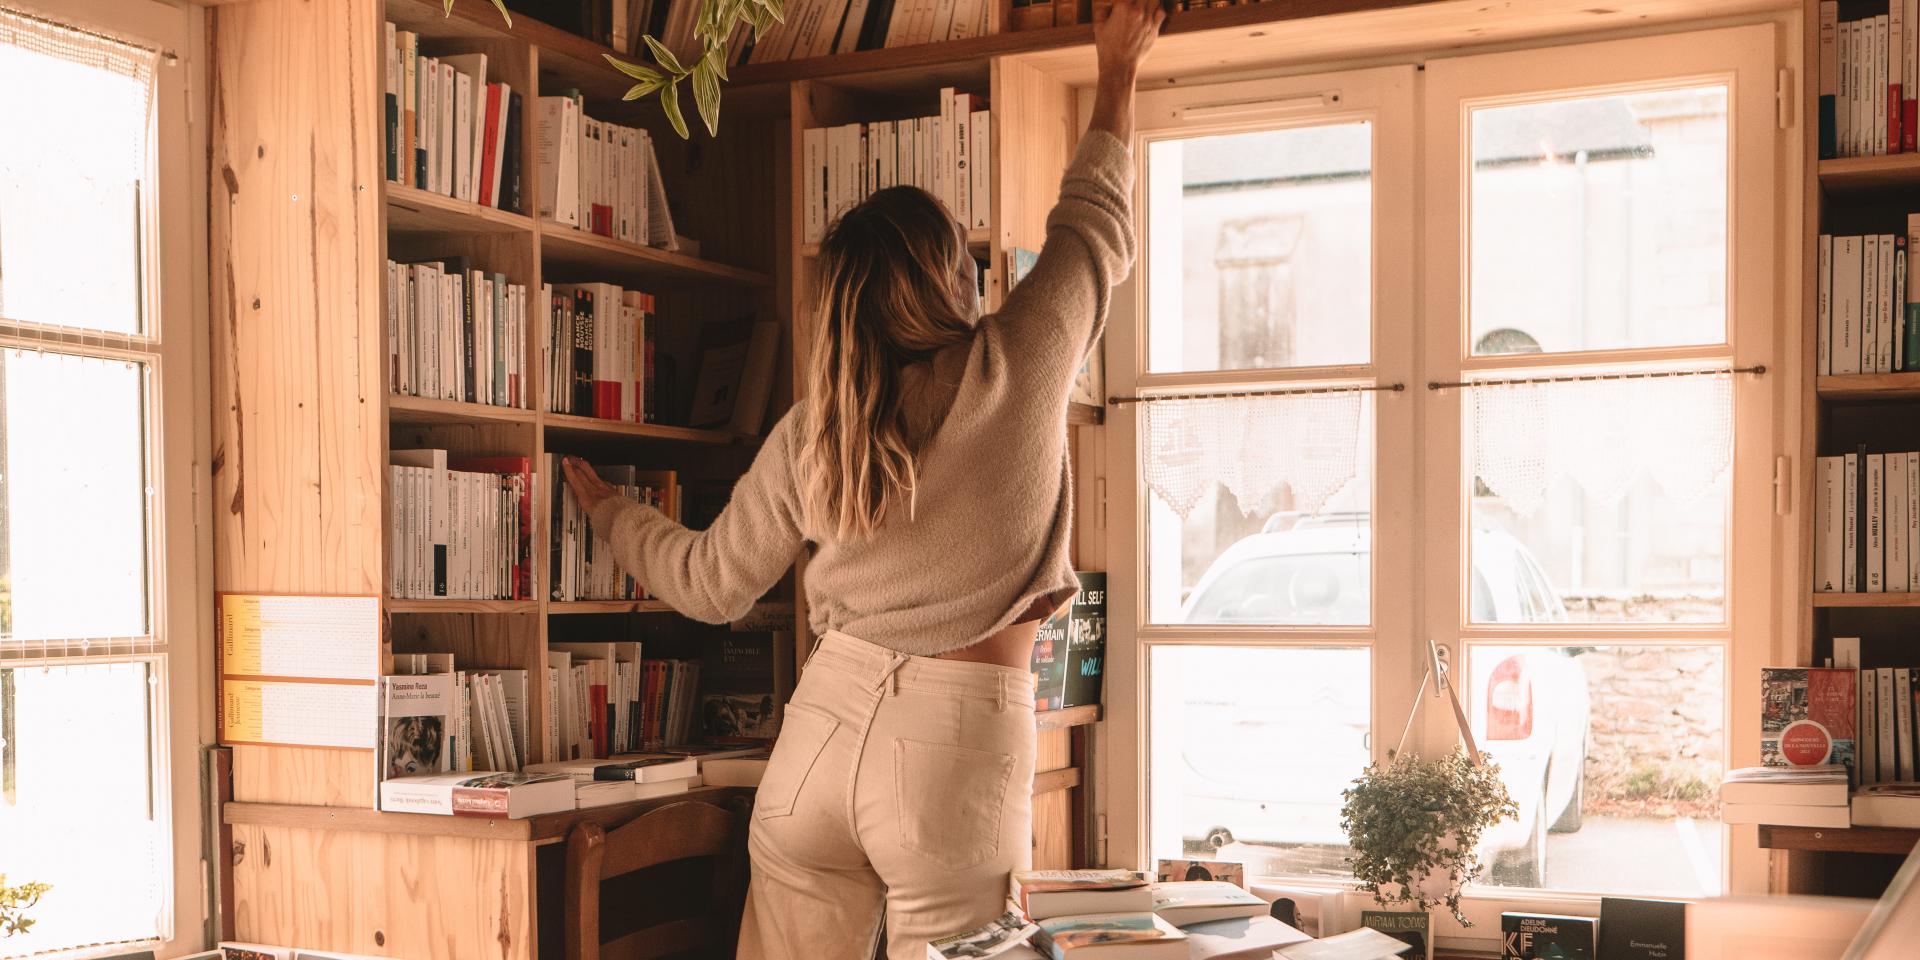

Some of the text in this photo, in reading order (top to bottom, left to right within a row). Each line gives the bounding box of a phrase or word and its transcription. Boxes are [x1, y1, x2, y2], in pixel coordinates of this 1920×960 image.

[1088, 591, 1104, 604] SELF
[1035, 629, 1065, 641] ERMAIN
[1081, 657, 1101, 676] WILL
[1365, 915, 1395, 927] MIRIAM
[1503, 932, 1534, 956] KE
[1630, 940, 1667, 949] Emmanuelle
